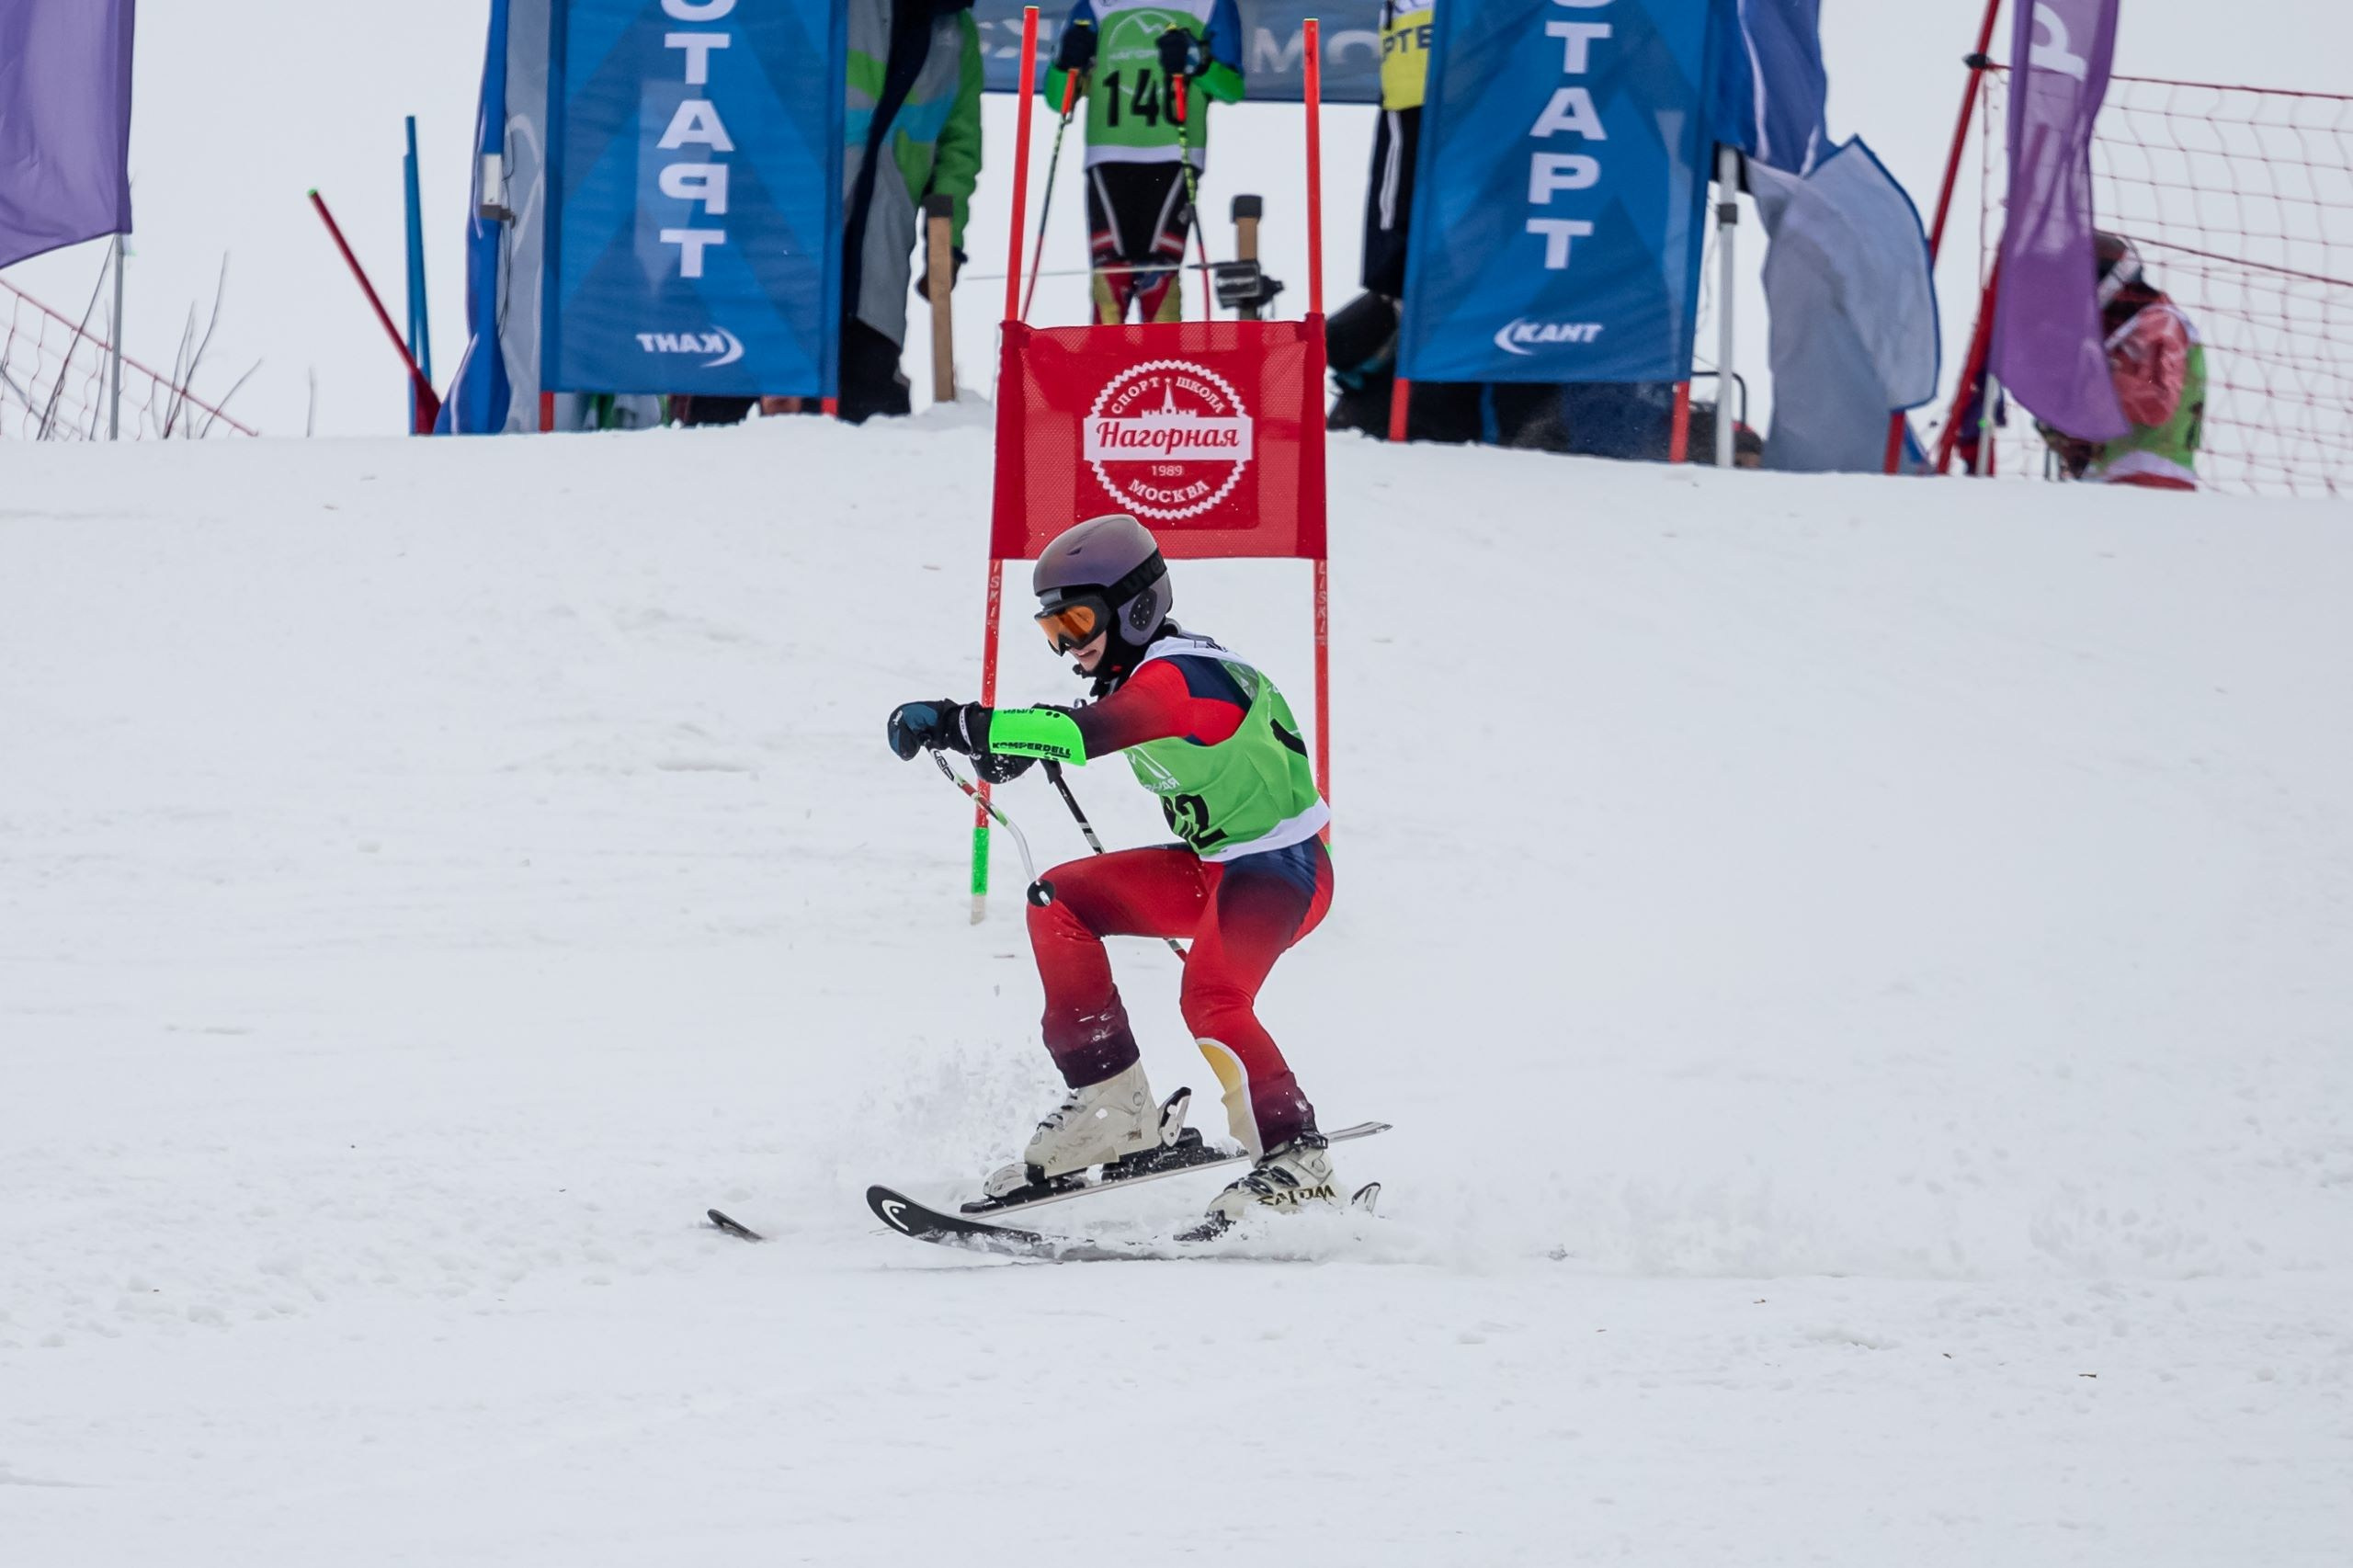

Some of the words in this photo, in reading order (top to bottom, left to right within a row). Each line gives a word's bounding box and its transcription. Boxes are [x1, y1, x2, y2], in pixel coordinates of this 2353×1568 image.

[1526, 0, 1616, 269] ТАРТ
[1513, 323, 1603, 343] КАНТ
[1111, 377, 1159, 414] СПОРТ
[1176, 377, 1225, 413] ШКОЛА
[1097, 421, 1239, 455] Нагорная
[1152, 465, 1183, 476] 1989
[1128, 479, 1210, 503] МОСКВА
[993, 742, 1072, 757] KOMPERDELL
